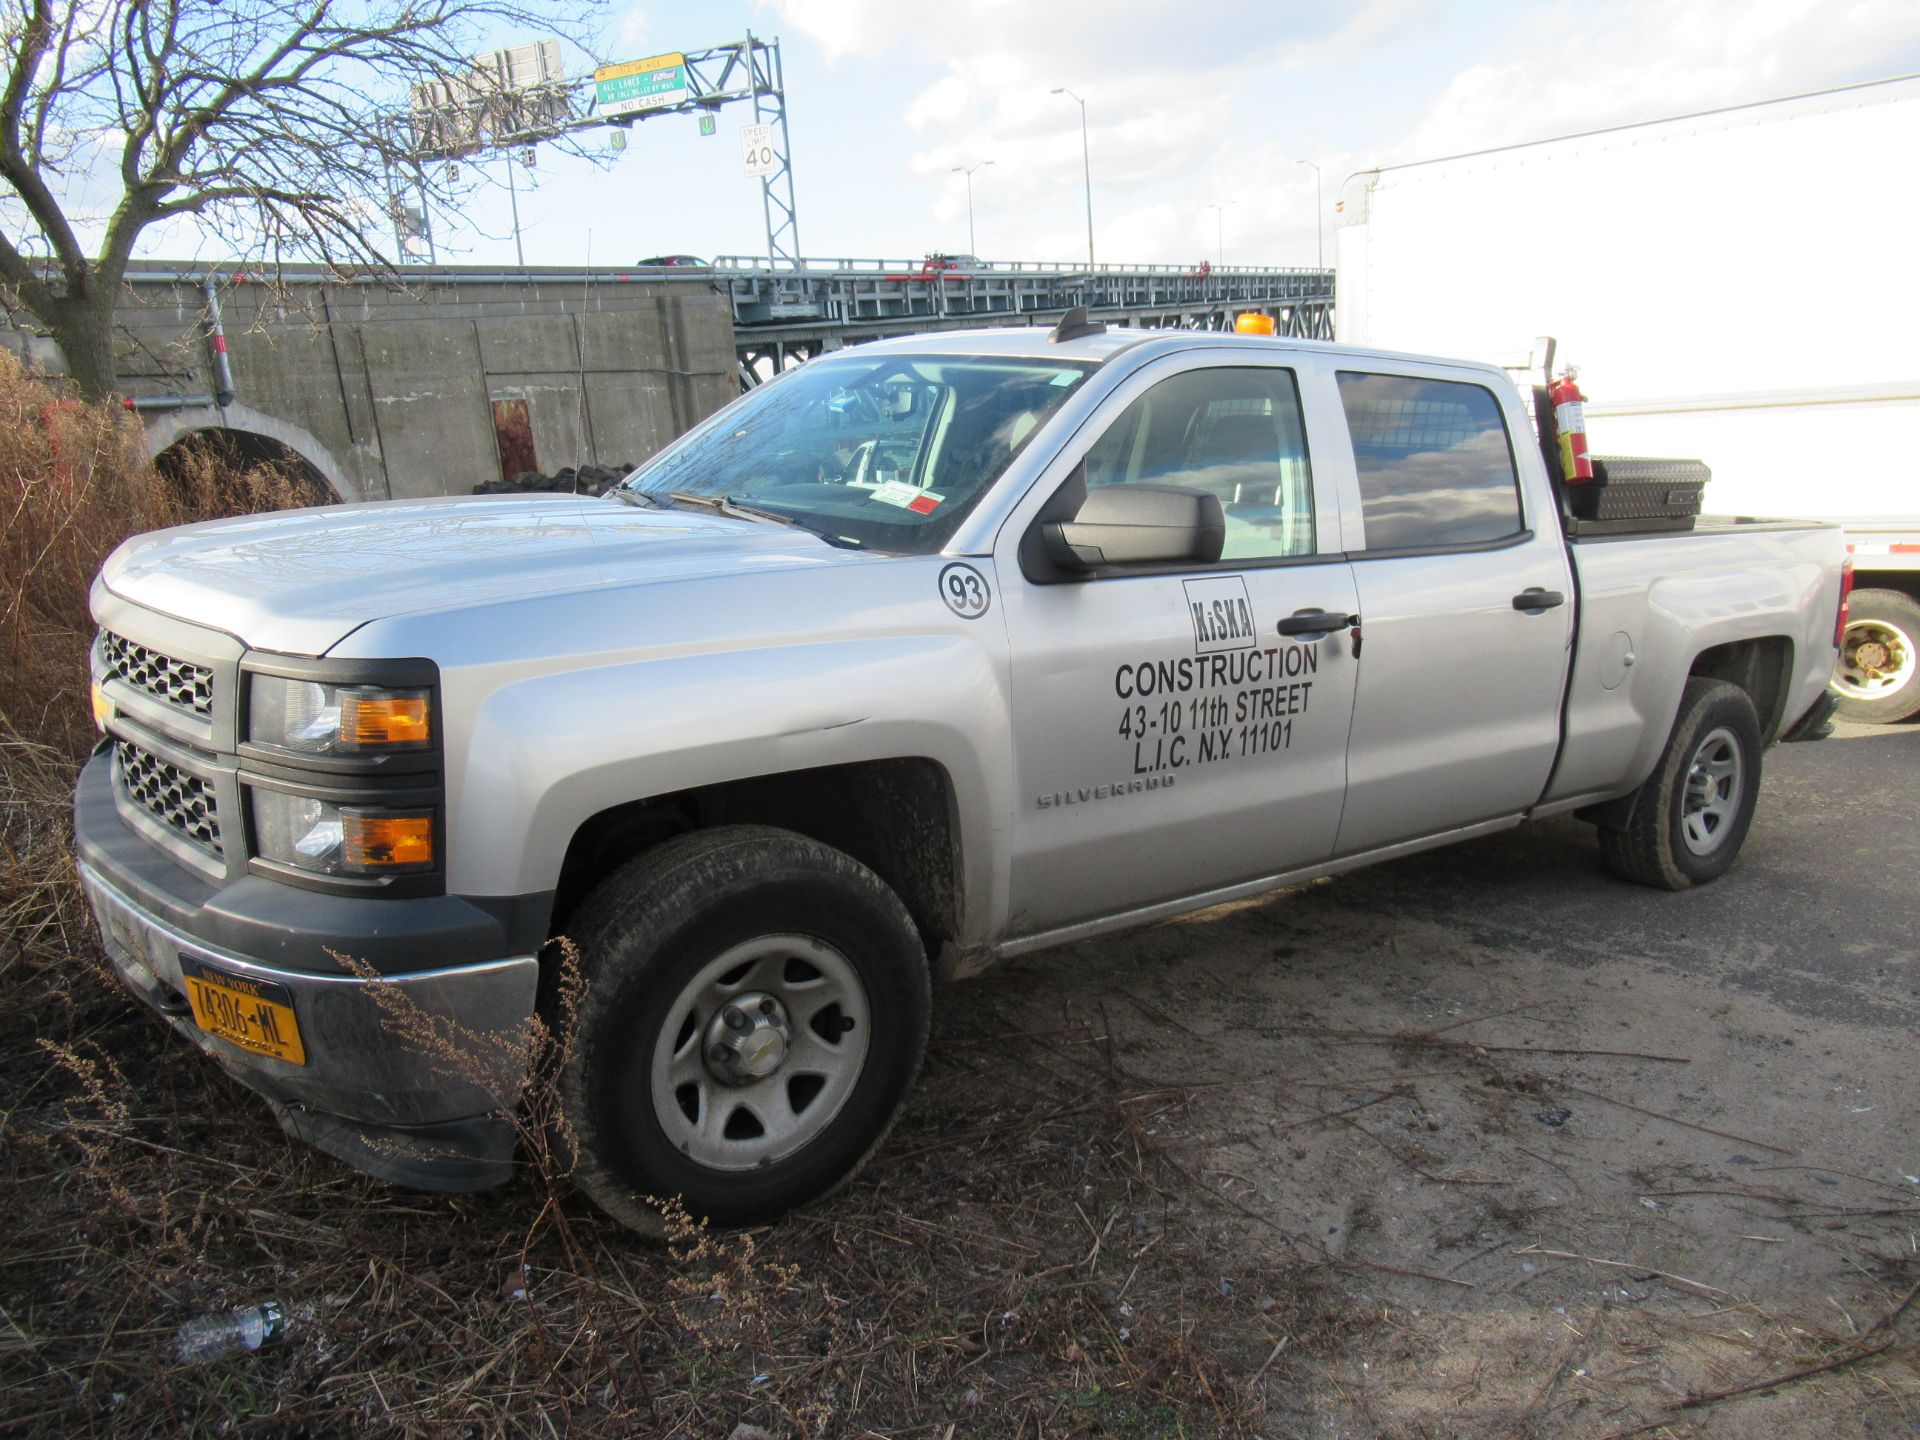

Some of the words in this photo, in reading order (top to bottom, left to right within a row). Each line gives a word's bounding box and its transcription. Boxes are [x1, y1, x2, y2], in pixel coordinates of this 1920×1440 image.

[603, 81, 615, 92] ALL
[619, 76, 640, 89] LANES
[621, 101, 634, 112] NO
[638, 95, 665, 108] CASH
[743, 127, 769, 138] SPEED
[746, 136, 767, 147] LIMIT
[746, 146, 771, 167] 40
[949, 575, 984, 609] 93
[1115, 643, 1318, 699] CONSTRUCTION
[1118, 700, 1182, 740] 43-10
[1189, 695, 1228, 730] 11th
[1235, 682, 1313, 723] STREET
[1134, 735, 1190, 774] L.I.C.
[1198, 728, 1233, 764] N.Y.
[1239, 719, 1293, 756] 11101
[1037, 773, 1176, 810] SILVERADO
[227, 977, 259, 996] YORK
